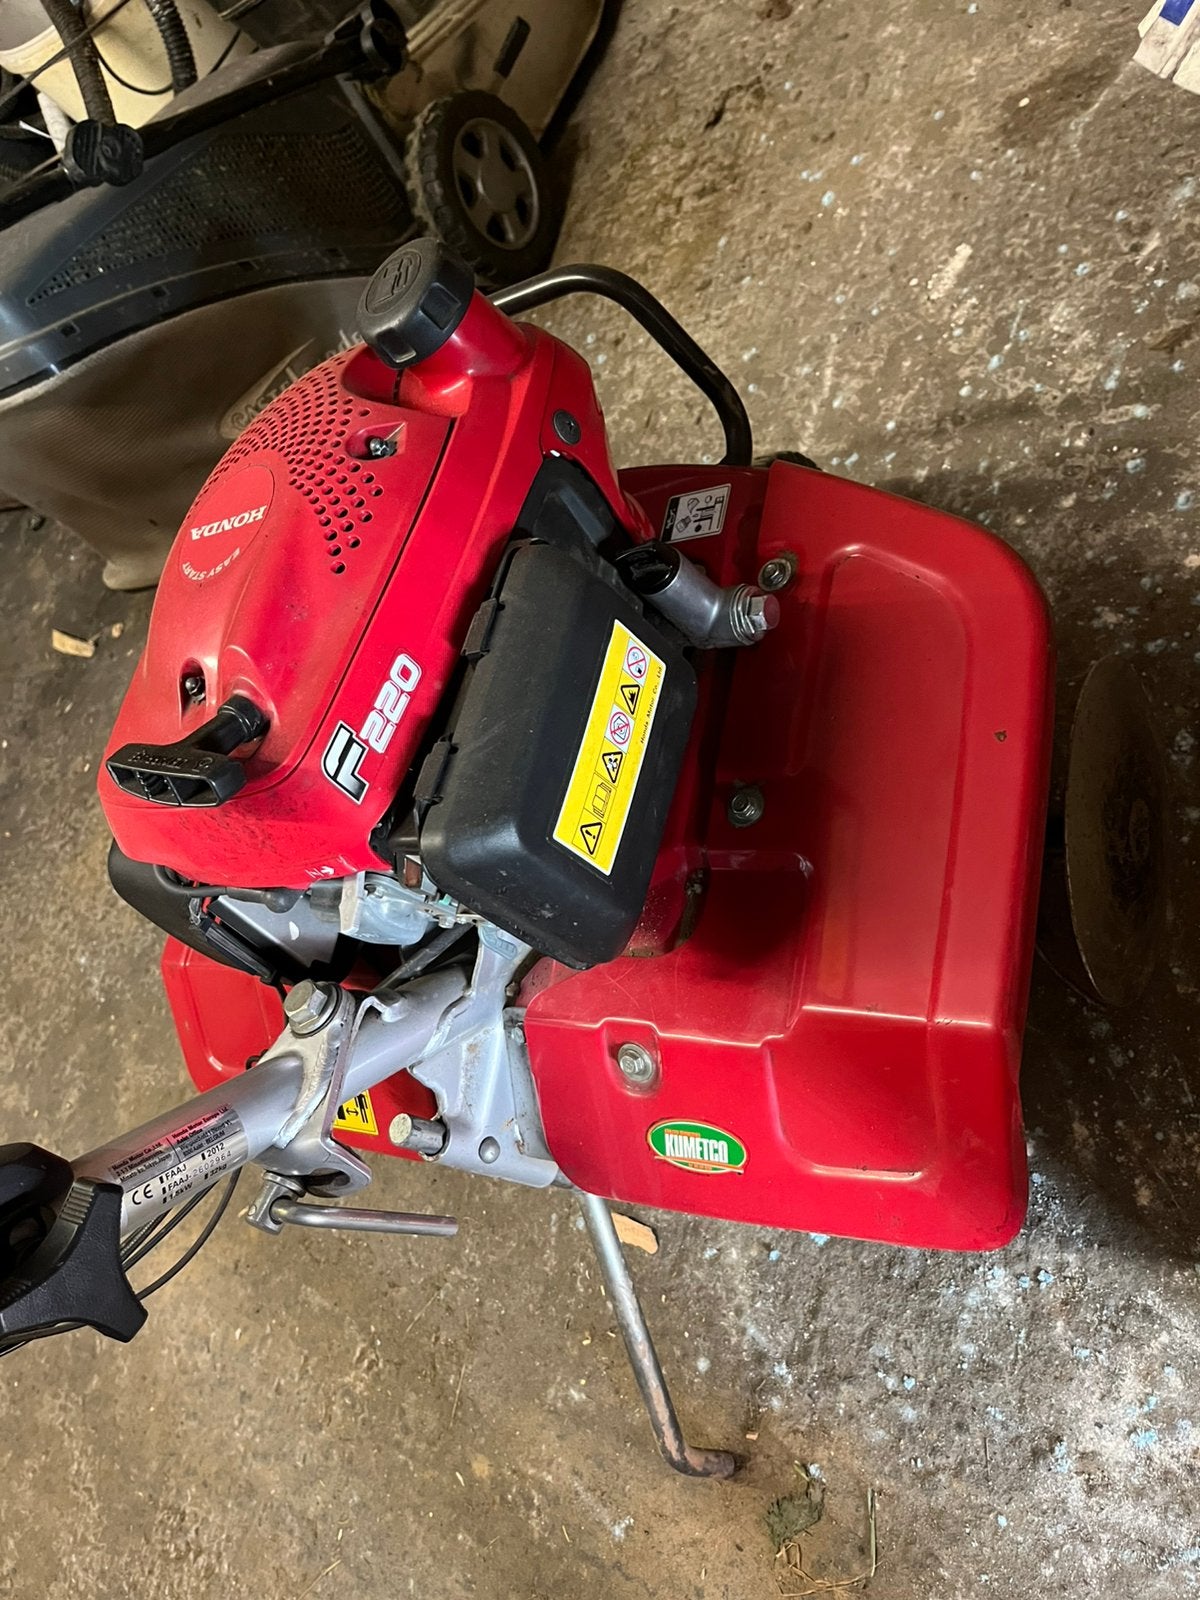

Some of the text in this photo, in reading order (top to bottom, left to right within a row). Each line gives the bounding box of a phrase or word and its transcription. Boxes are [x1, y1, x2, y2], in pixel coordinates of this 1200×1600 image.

[191, 505, 267, 541] HONDA
[182, 547, 240, 580] EASY START
[321, 653, 422, 805] F220
[206, 1142, 226, 1157] 2012
[664, 1133, 729, 1164] KUMETCO
[164, 1163, 187, 1180] FAAJ
